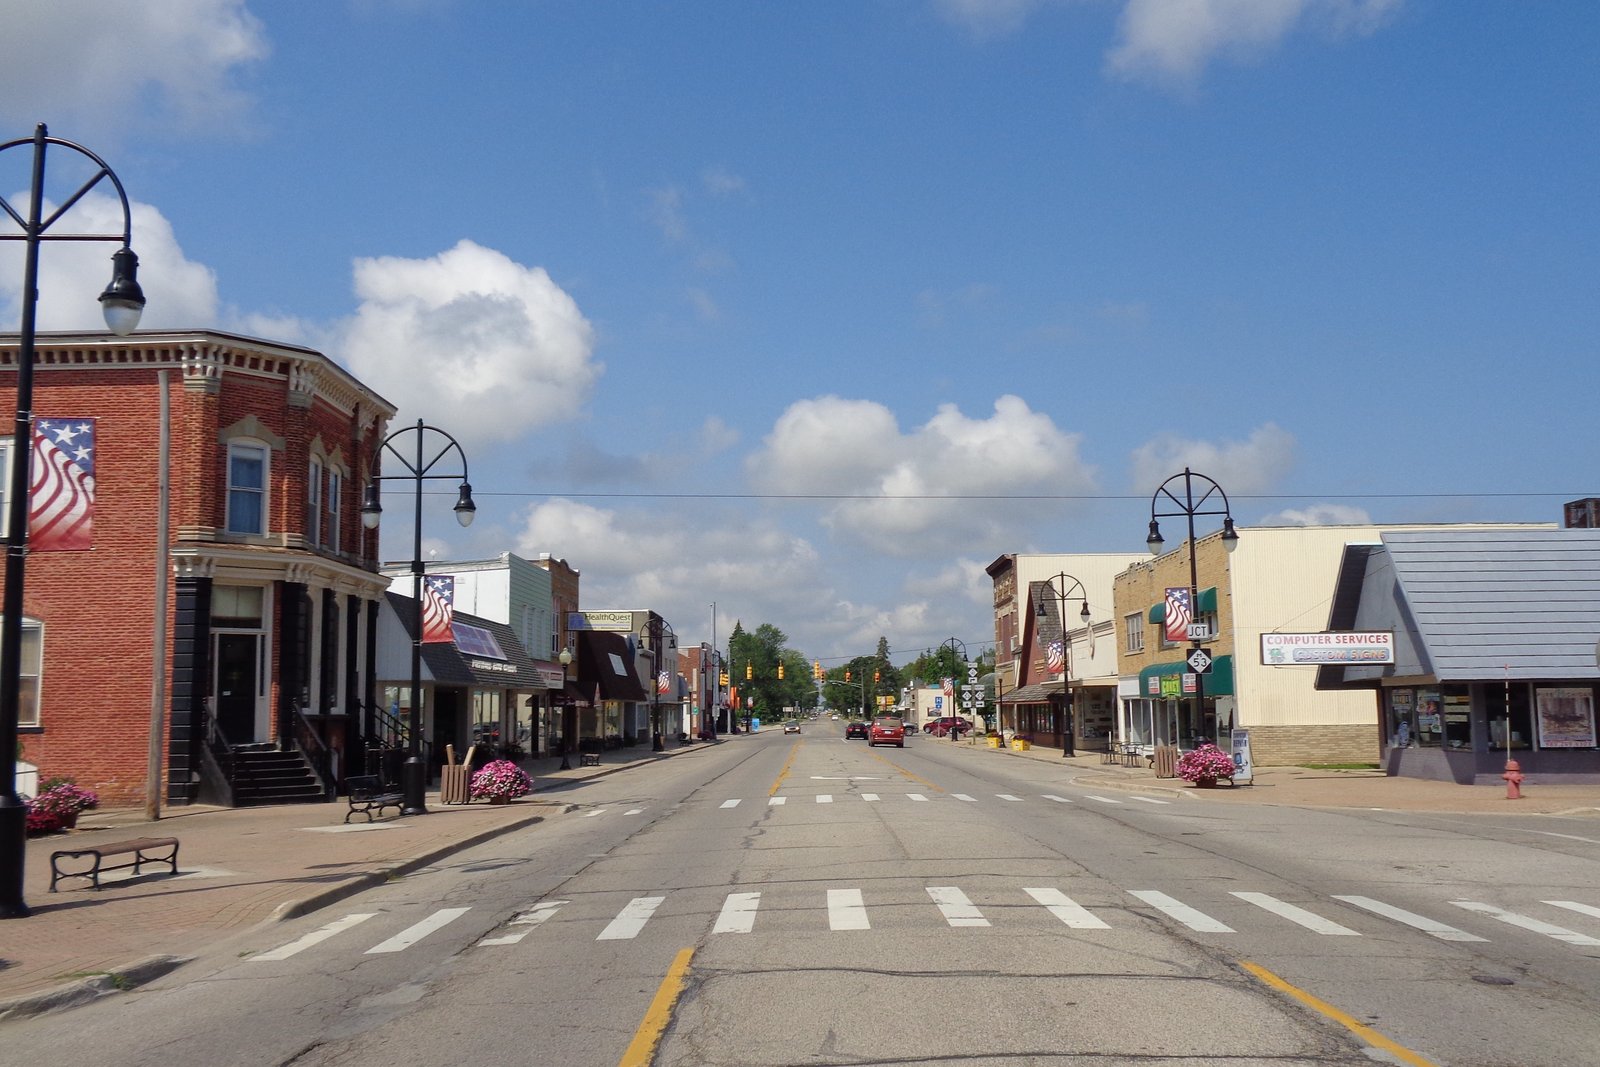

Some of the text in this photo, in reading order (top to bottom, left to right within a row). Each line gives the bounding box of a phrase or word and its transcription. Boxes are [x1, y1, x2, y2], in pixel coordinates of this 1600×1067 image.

[584, 613, 631, 622] HealthQuest
[1188, 626, 1207, 637] JCT
[1266, 634, 1388, 645] COMPUTER SERVICES
[1296, 649, 1386, 660] CUSTOM SIGNS
[1193, 657, 1207, 667] 53
